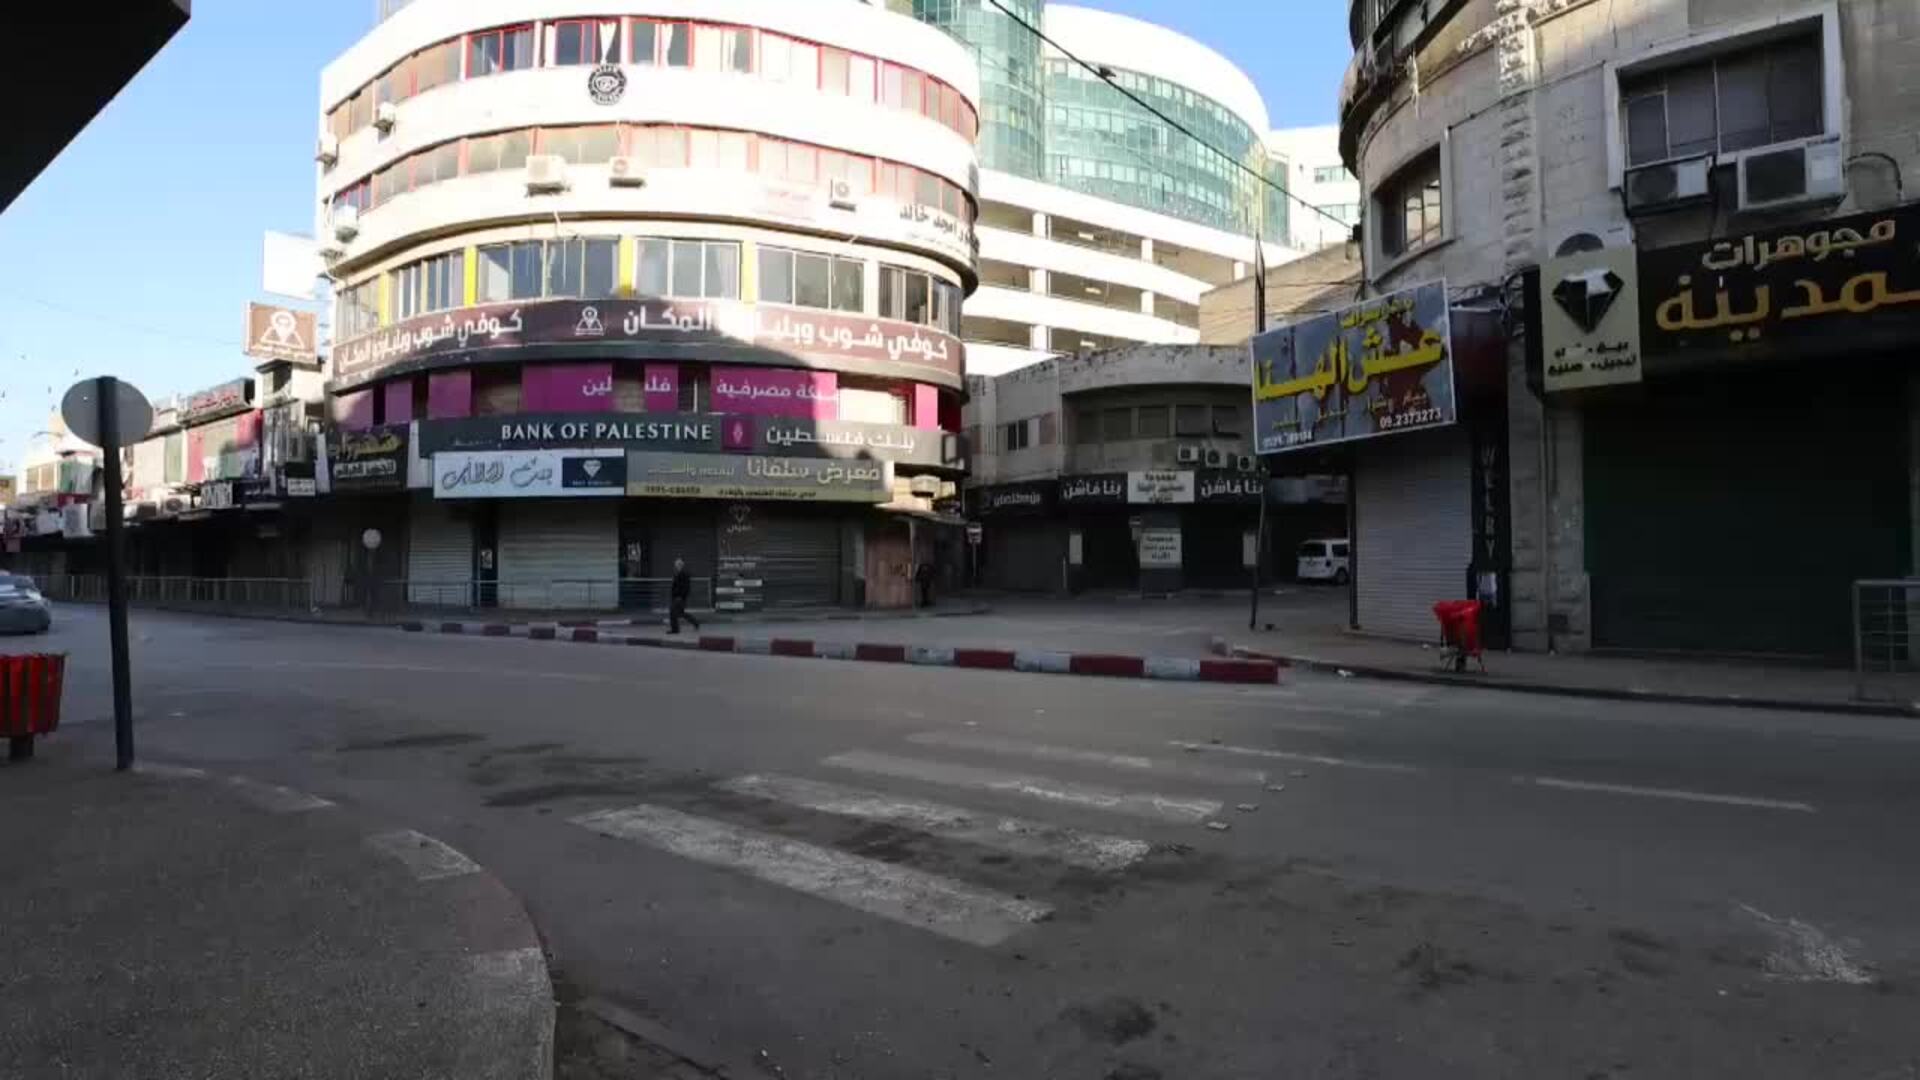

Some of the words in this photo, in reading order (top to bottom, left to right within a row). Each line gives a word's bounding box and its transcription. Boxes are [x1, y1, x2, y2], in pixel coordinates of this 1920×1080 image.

[1702, 219, 1896, 270] مجوهرات
[1655, 272, 1920, 342] مدينة
[412, 315, 456, 348] شوب
[458, 310, 523, 347] كوفي
[623, 304, 712, 336] المكان
[819, 323, 884, 350] شوب
[887, 339, 948, 362] كوفي
[716, 378, 791, 400] مصرفية
[501, 423, 555, 441] BANK
[560, 423, 590, 441] OF
[594, 422, 713, 441] PALESTINE
[765, 424, 864, 448] فلسطين
[868, 428, 915, 453] بنك
[747, 457, 810, 480] سلفانا
[817, 459, 880, 485] معرض
[1063, 480, 1101, 499] فاشن
[1102, 482, 1121, 498] بنا
[1200, 479, 1243, 498] فاشن
[1245, 479, 1264, 495] بنا
